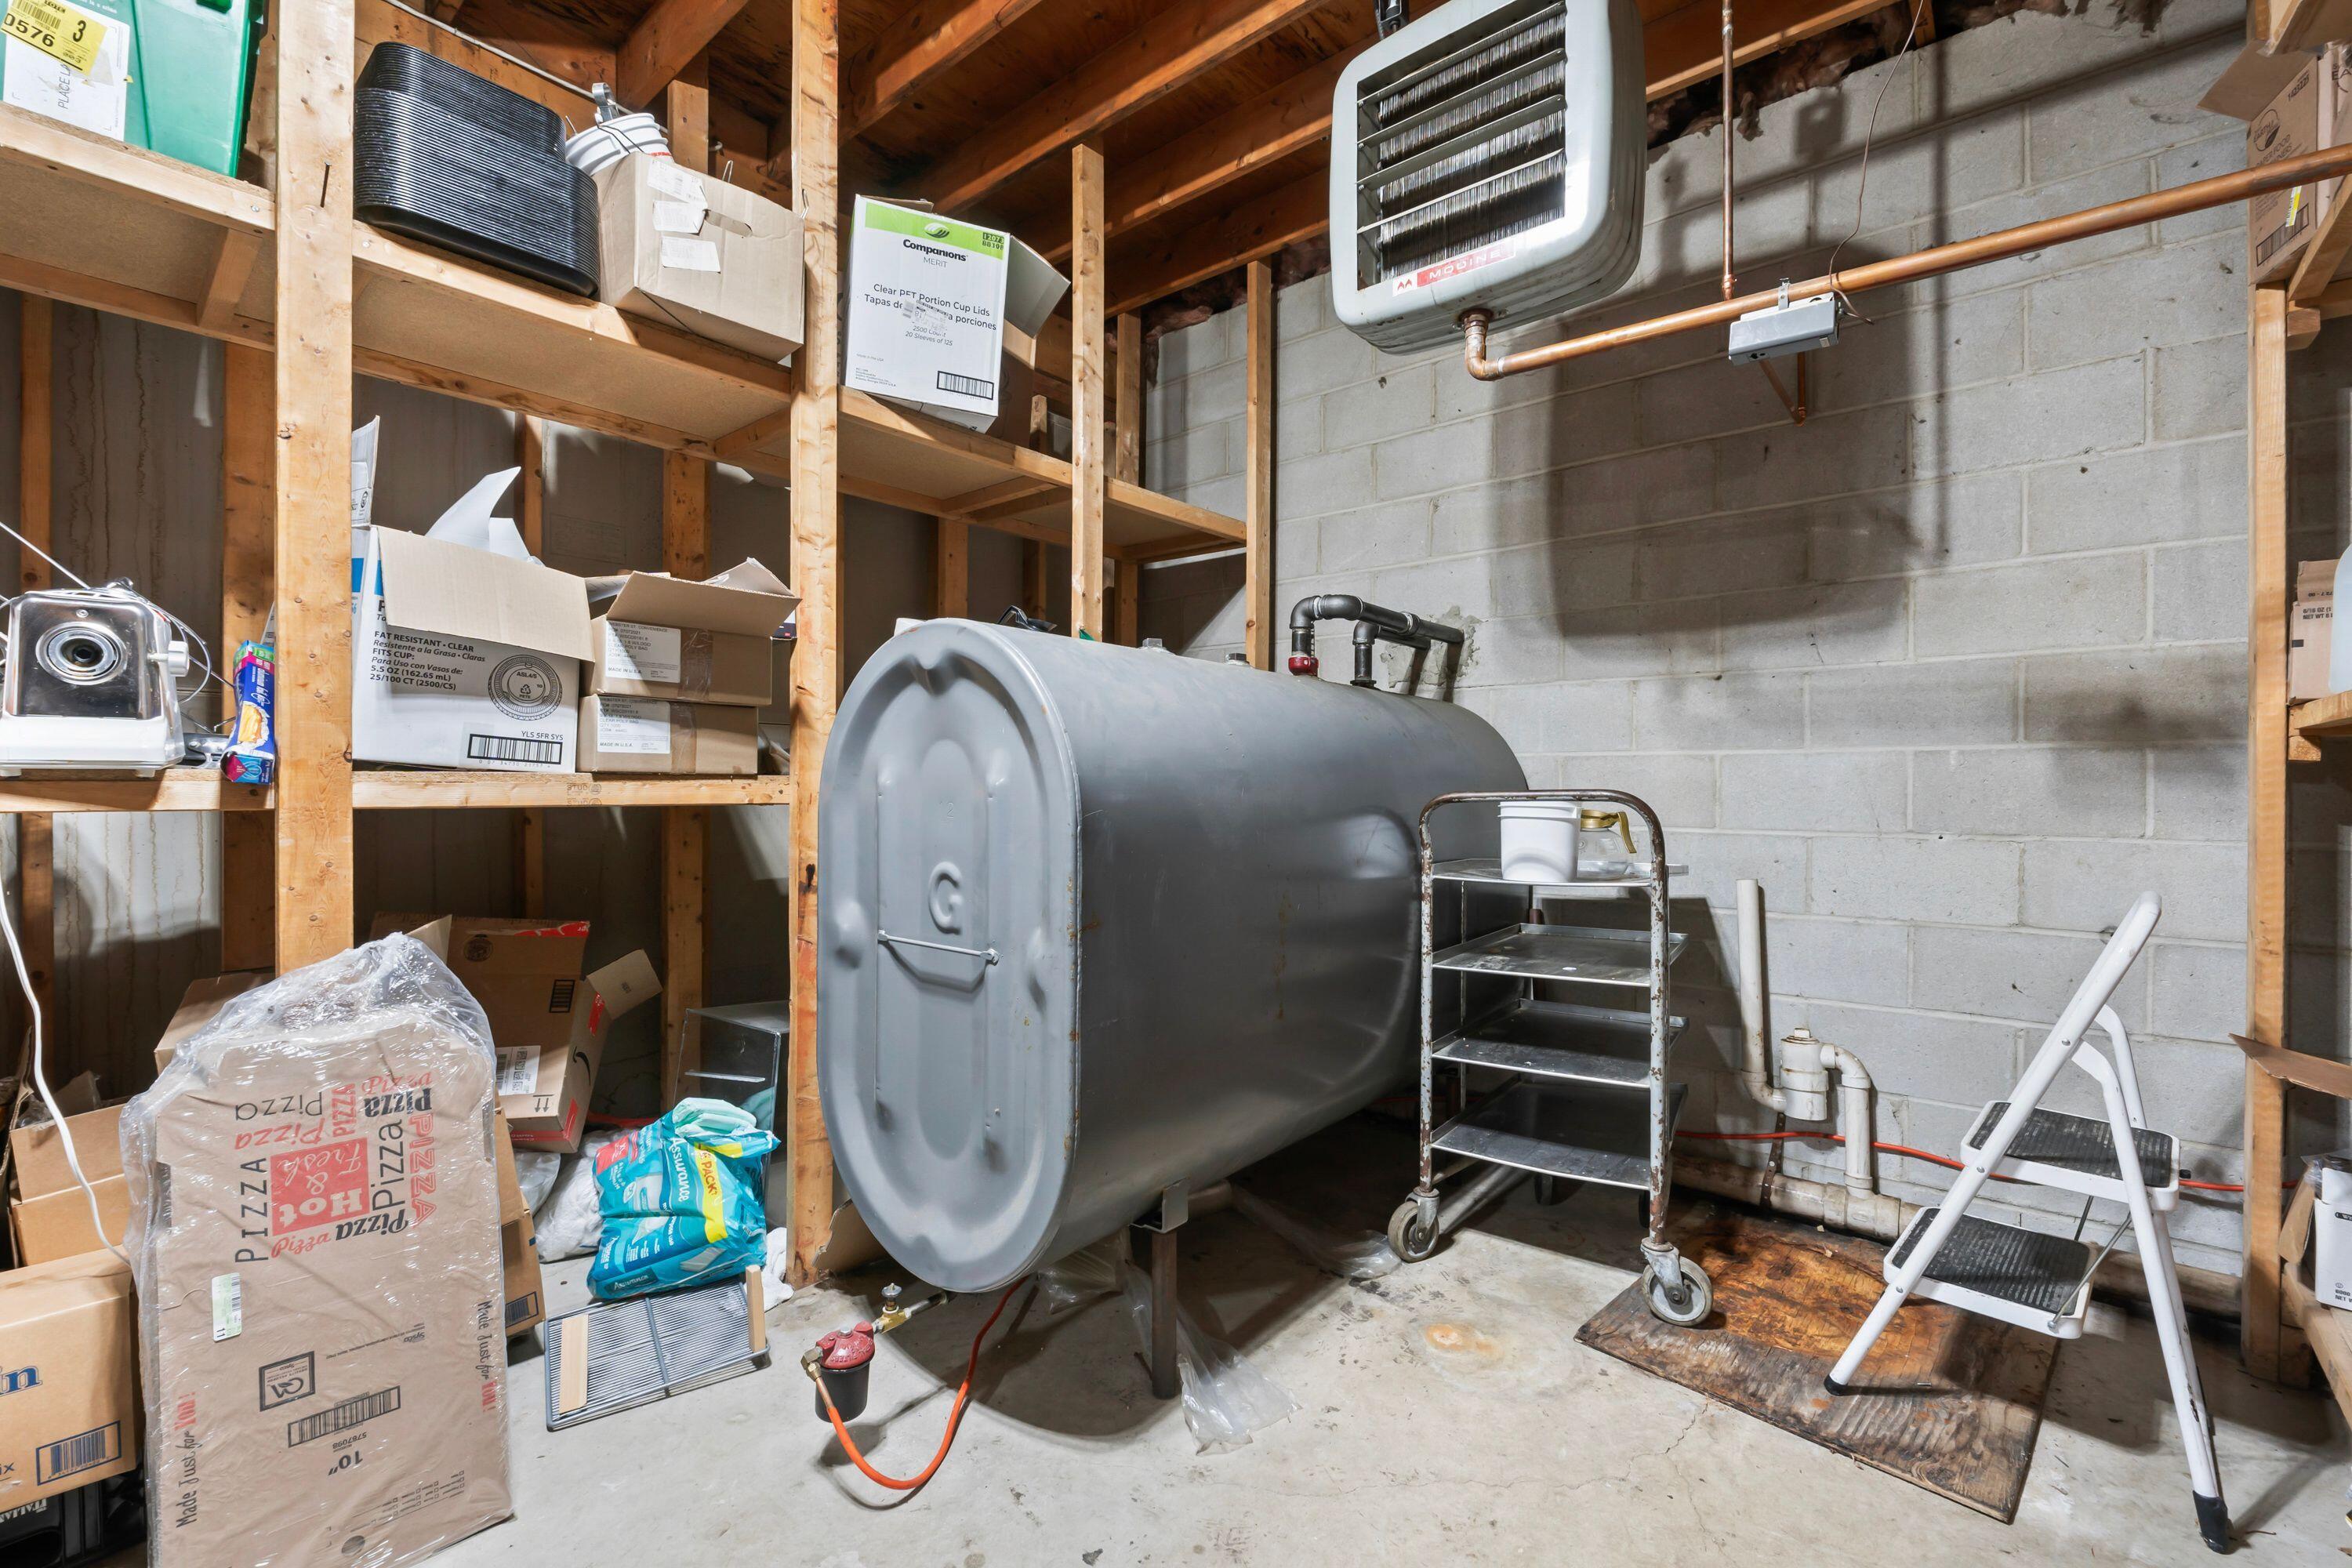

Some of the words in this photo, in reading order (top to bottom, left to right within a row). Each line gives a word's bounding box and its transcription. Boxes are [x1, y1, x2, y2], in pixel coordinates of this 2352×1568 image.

[72, 20, 87, 42] 3
[57, 77, 71, 110] PLACE
[902, 238, 967, 261] Companions
[923, 256, 948, 268] MERIT
[1429, 249, 1501, 280] MODINE
[864, 293, 891, 307] Tapas
[955, 315, 997, 331] porciones
[873, 283, 897, 296] Clear
[919, 293, 951, 308] Portion
[953, 301, 971, 313] Cup
[973, 304, 991, 317] Lids
[913, 325, 927, 334] 2500
[913, 332, 936, 343] Sleeves
[944, 338, 953, 347] 125
[372, 648, 392, 657] FITS
[394, 651, 415, 660] CUP:
[373, 639, 416, 652] Resistente
[434, 648, 456, 658] Grasa
[462, 652, 485, 662] Claras
[374, 630, 392, 639] FAT
[394, 633, 441, 648] RESISTANT
[448, 642, 474, 652] CLEAR
[372, 656, 391, 666] Para
[394, 659, 409, 668] Uso
[410, 662, 425, 670] con
[426, 663, 449, 673] Vasos
[451, 666, 463, 675] de:
[401, 669, 434, 680] (162.65
[435, 671, 451, 682] mL)
[370, 673, 401, 684] 25/100
[416, 679, 456, 691] (2500/CS)
[927, 861, 963, 936] G
[235, 1091, 323, 1120] Pizza
[332, 1083, 358, 1138] PIZZA
[364, 1087, 433, 1118] Pizza
[234, 1117, 326, 1150] Pizza
[277, 1143, 362, 1186] Fresh
[371, 1119, 406, 1211] Pizza
[408, 1112, 437, 1229] PIZZA
[669, 1137, 691, 1202] Assurance
[306, 1171, 328, 1195] &
[235, 1158, 269, 1262] PIZZA
[279, 1187, 362, 1228] Hot
[336, 1208, 409, 1241] Pizza
[270, 1230, 332, 1258] Pizza
[477, 1299, 493, 1330] Made
[477, 1333, 493, 1363] Just
[0, 1363, 43, 1400] n
[475, 1363, 495, 1381] for
[175, 1430, 202, 1449] for
[178, 1450, 200, 1488] Just
[176, 1490, 198, 1529] Made
